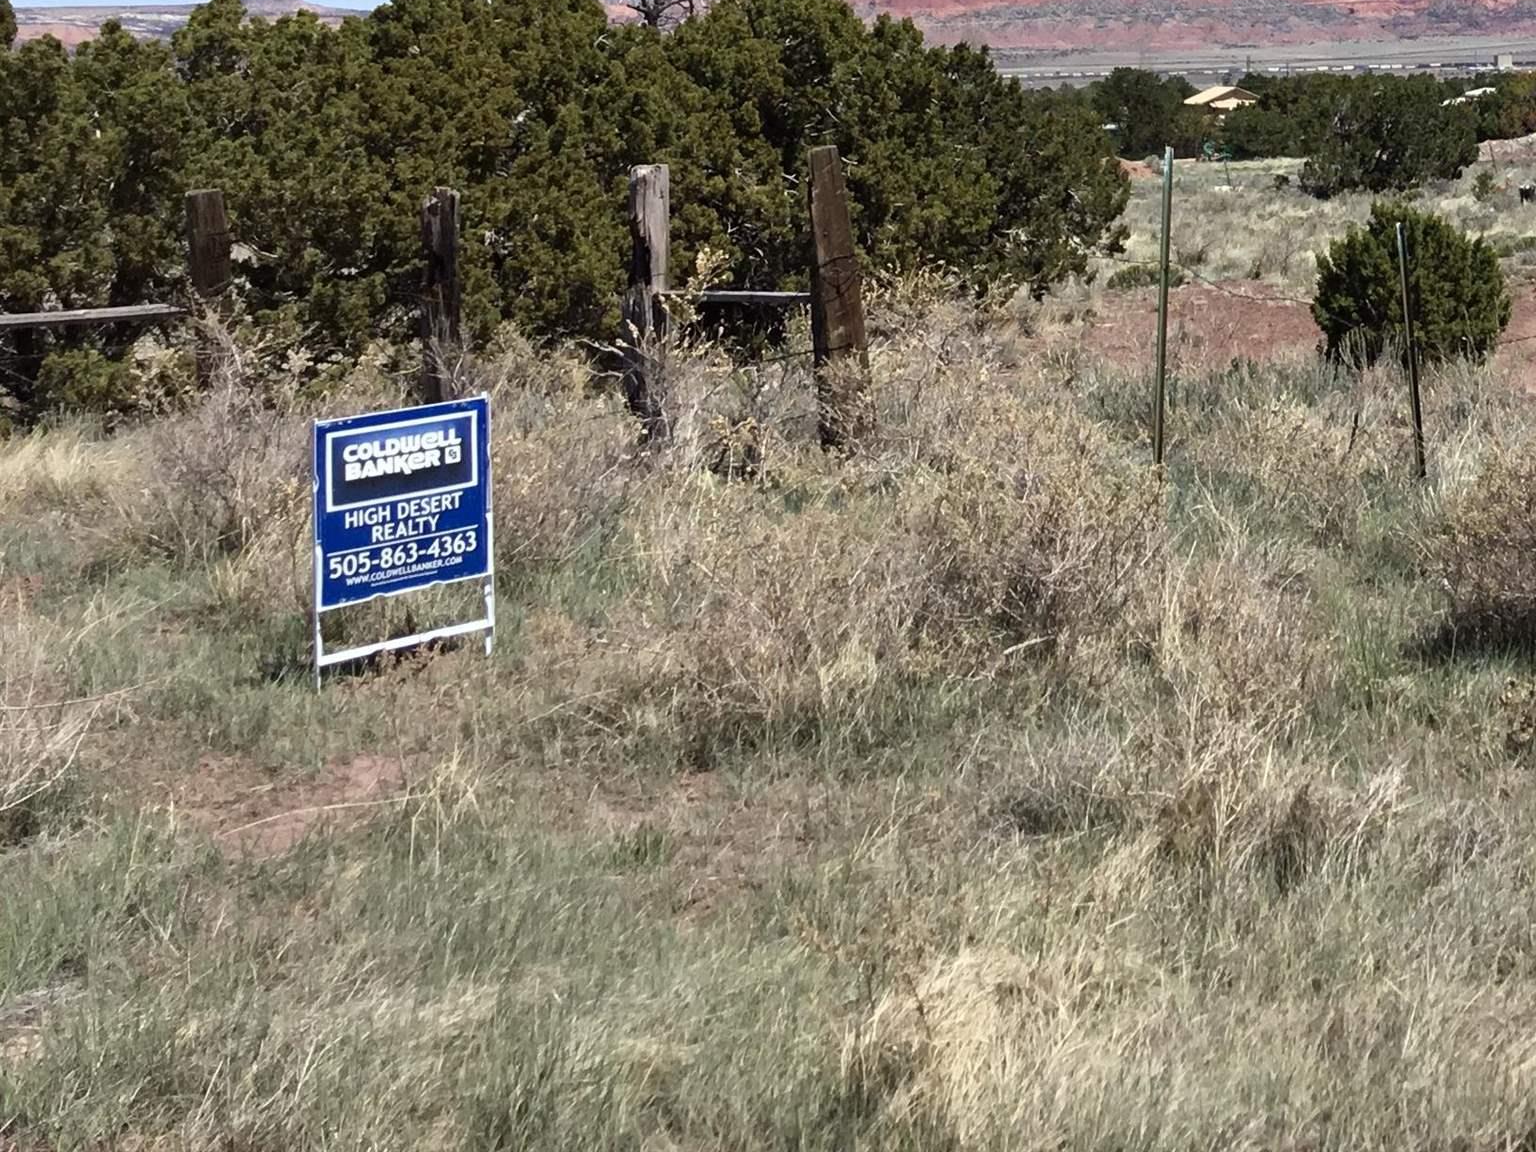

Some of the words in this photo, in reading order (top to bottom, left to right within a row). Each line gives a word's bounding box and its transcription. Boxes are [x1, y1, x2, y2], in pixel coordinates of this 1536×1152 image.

[343, 428, 461, 462] COLDWELL
[345, 449, 440, 481] BANKER
[345, 504, 391, 529] HIGH
[397, 492, 463, 520] DESERT
[372, 515, 440, 543] REALTY
[329, 531, 477, 579] 505-863-4363
[346, 556, 462, 586] WWW.COLDWELLBANKER.COM
